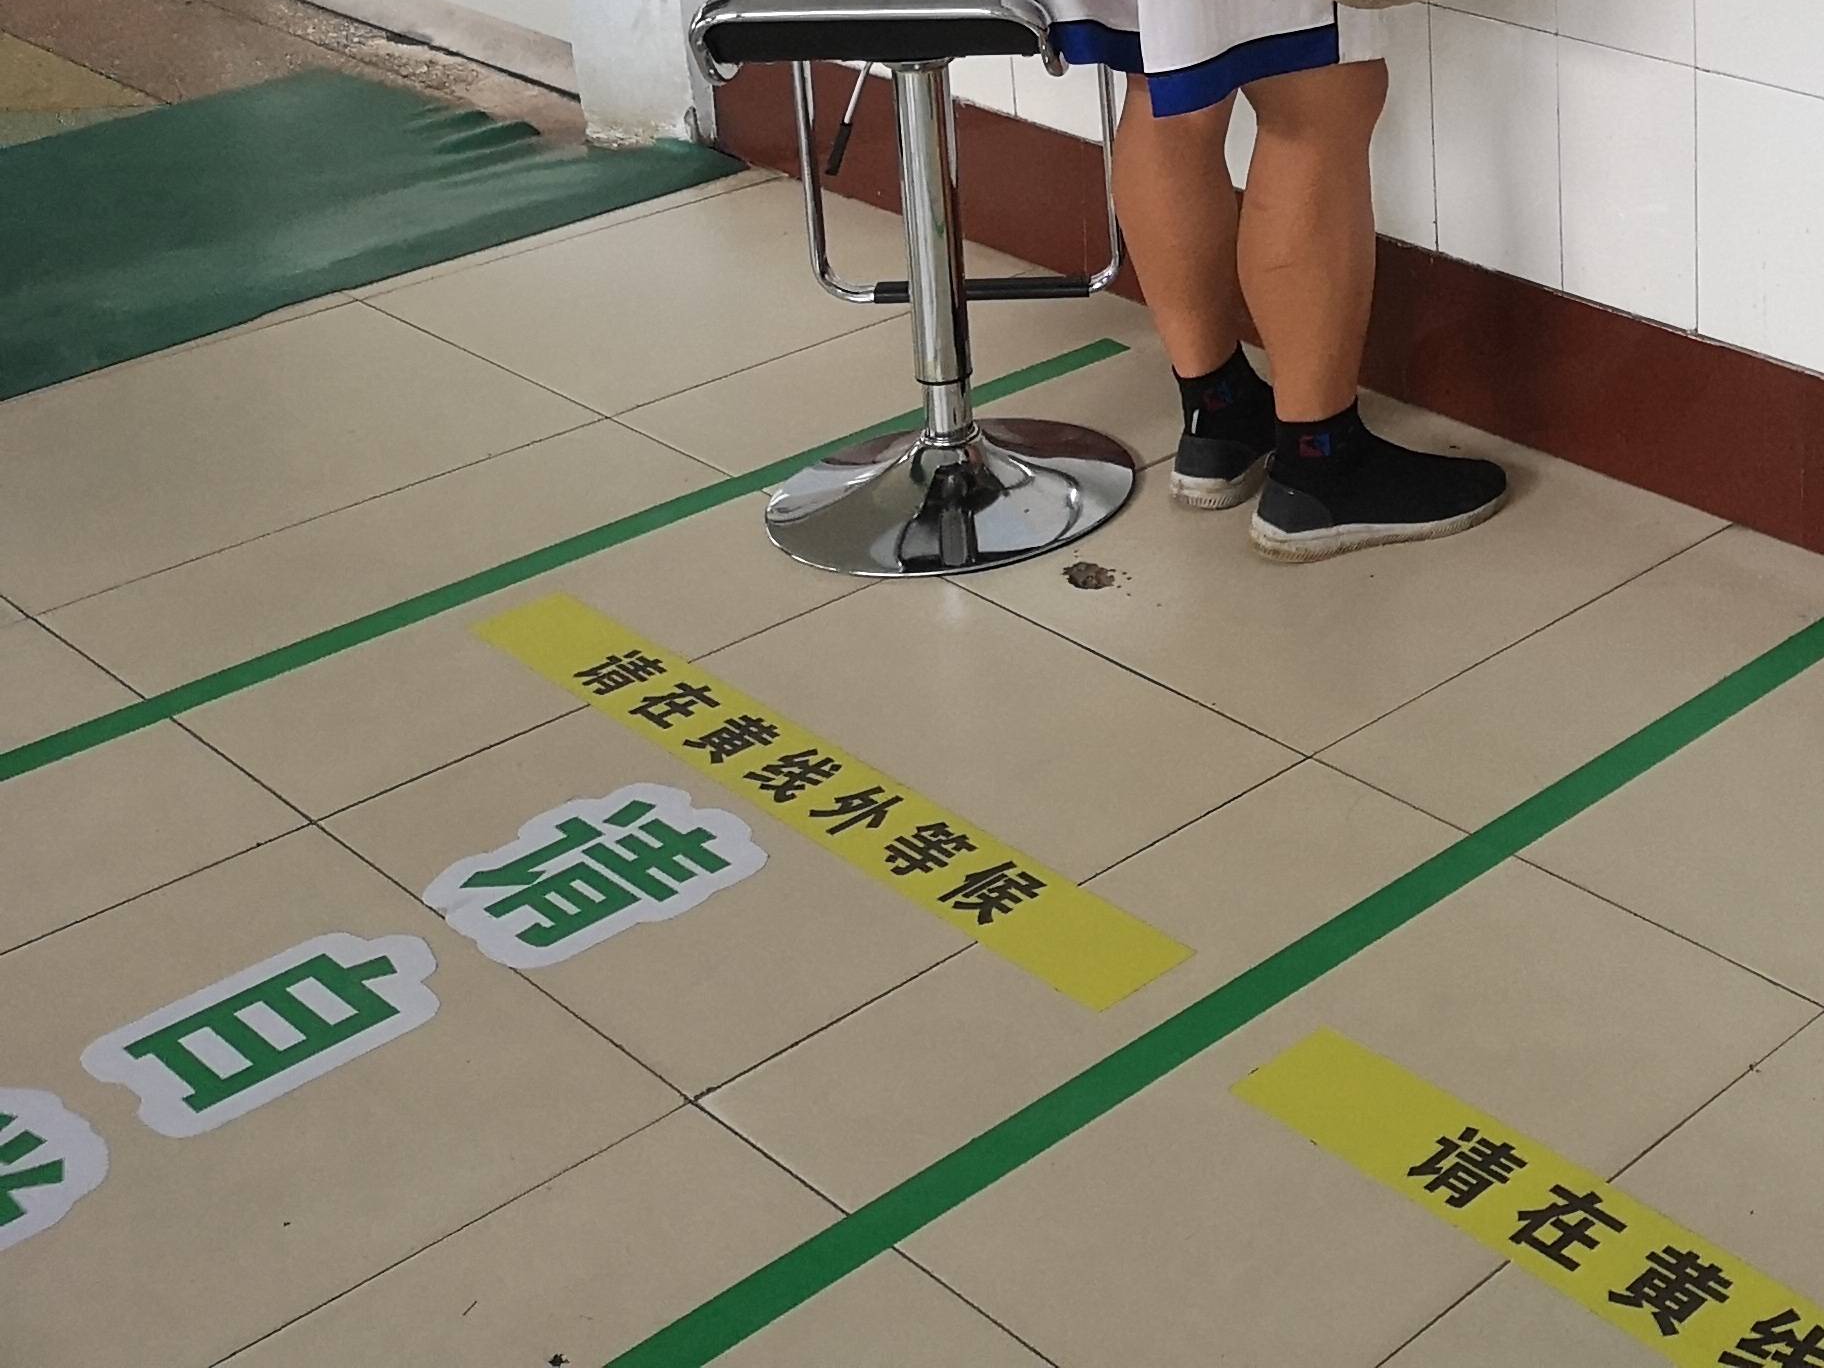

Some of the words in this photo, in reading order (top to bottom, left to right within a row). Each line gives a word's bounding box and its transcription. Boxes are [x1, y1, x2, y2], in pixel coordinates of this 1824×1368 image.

[573, 649, 1048, 925] 请在黄线外等候
